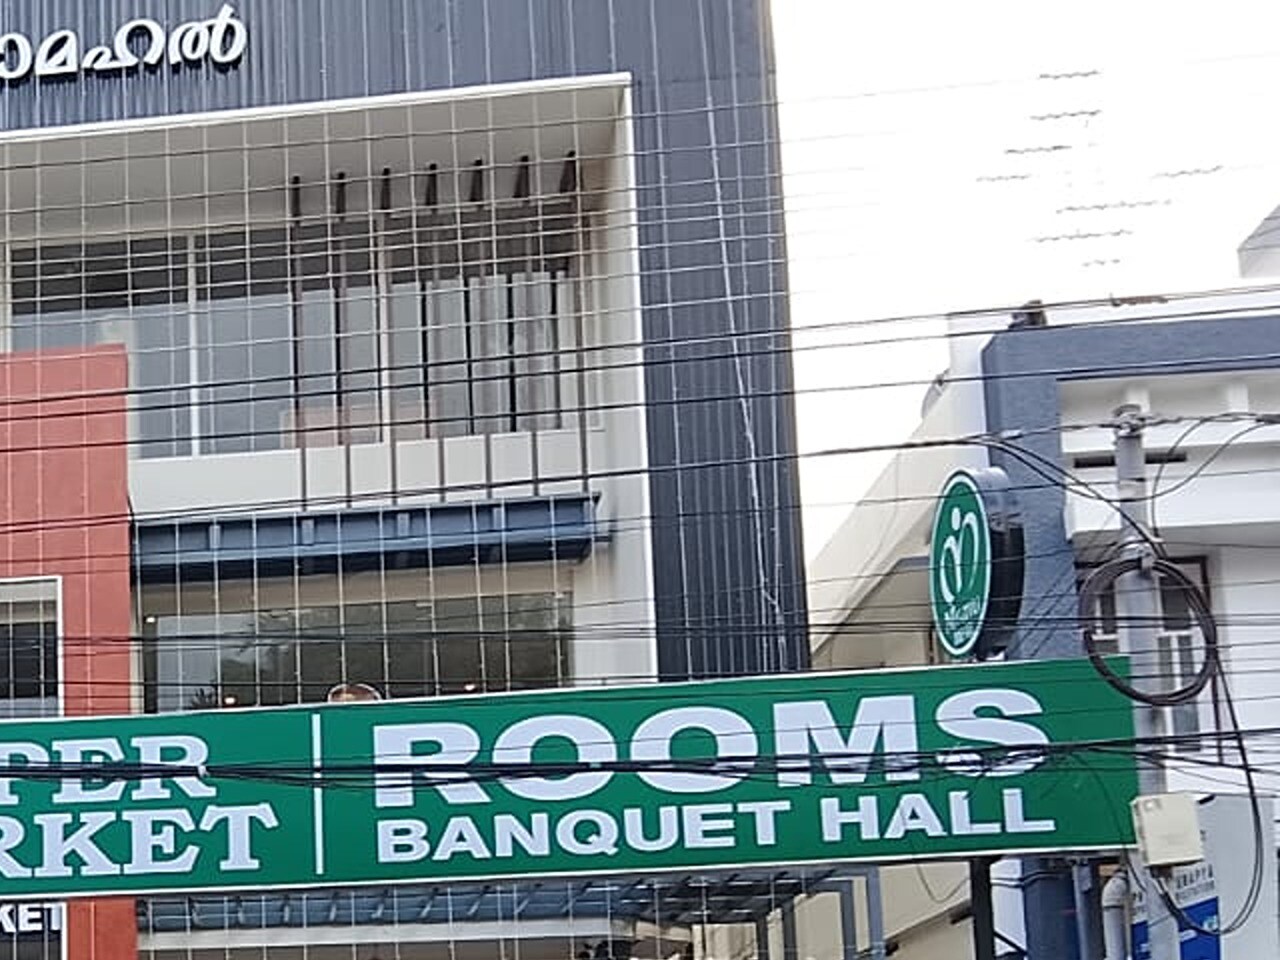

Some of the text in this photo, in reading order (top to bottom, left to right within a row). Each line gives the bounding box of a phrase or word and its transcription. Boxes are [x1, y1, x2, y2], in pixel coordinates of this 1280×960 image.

[373, 688, 1051, 809] ROOMS
[377, 788, 1056, 864] BANQUET HALL
